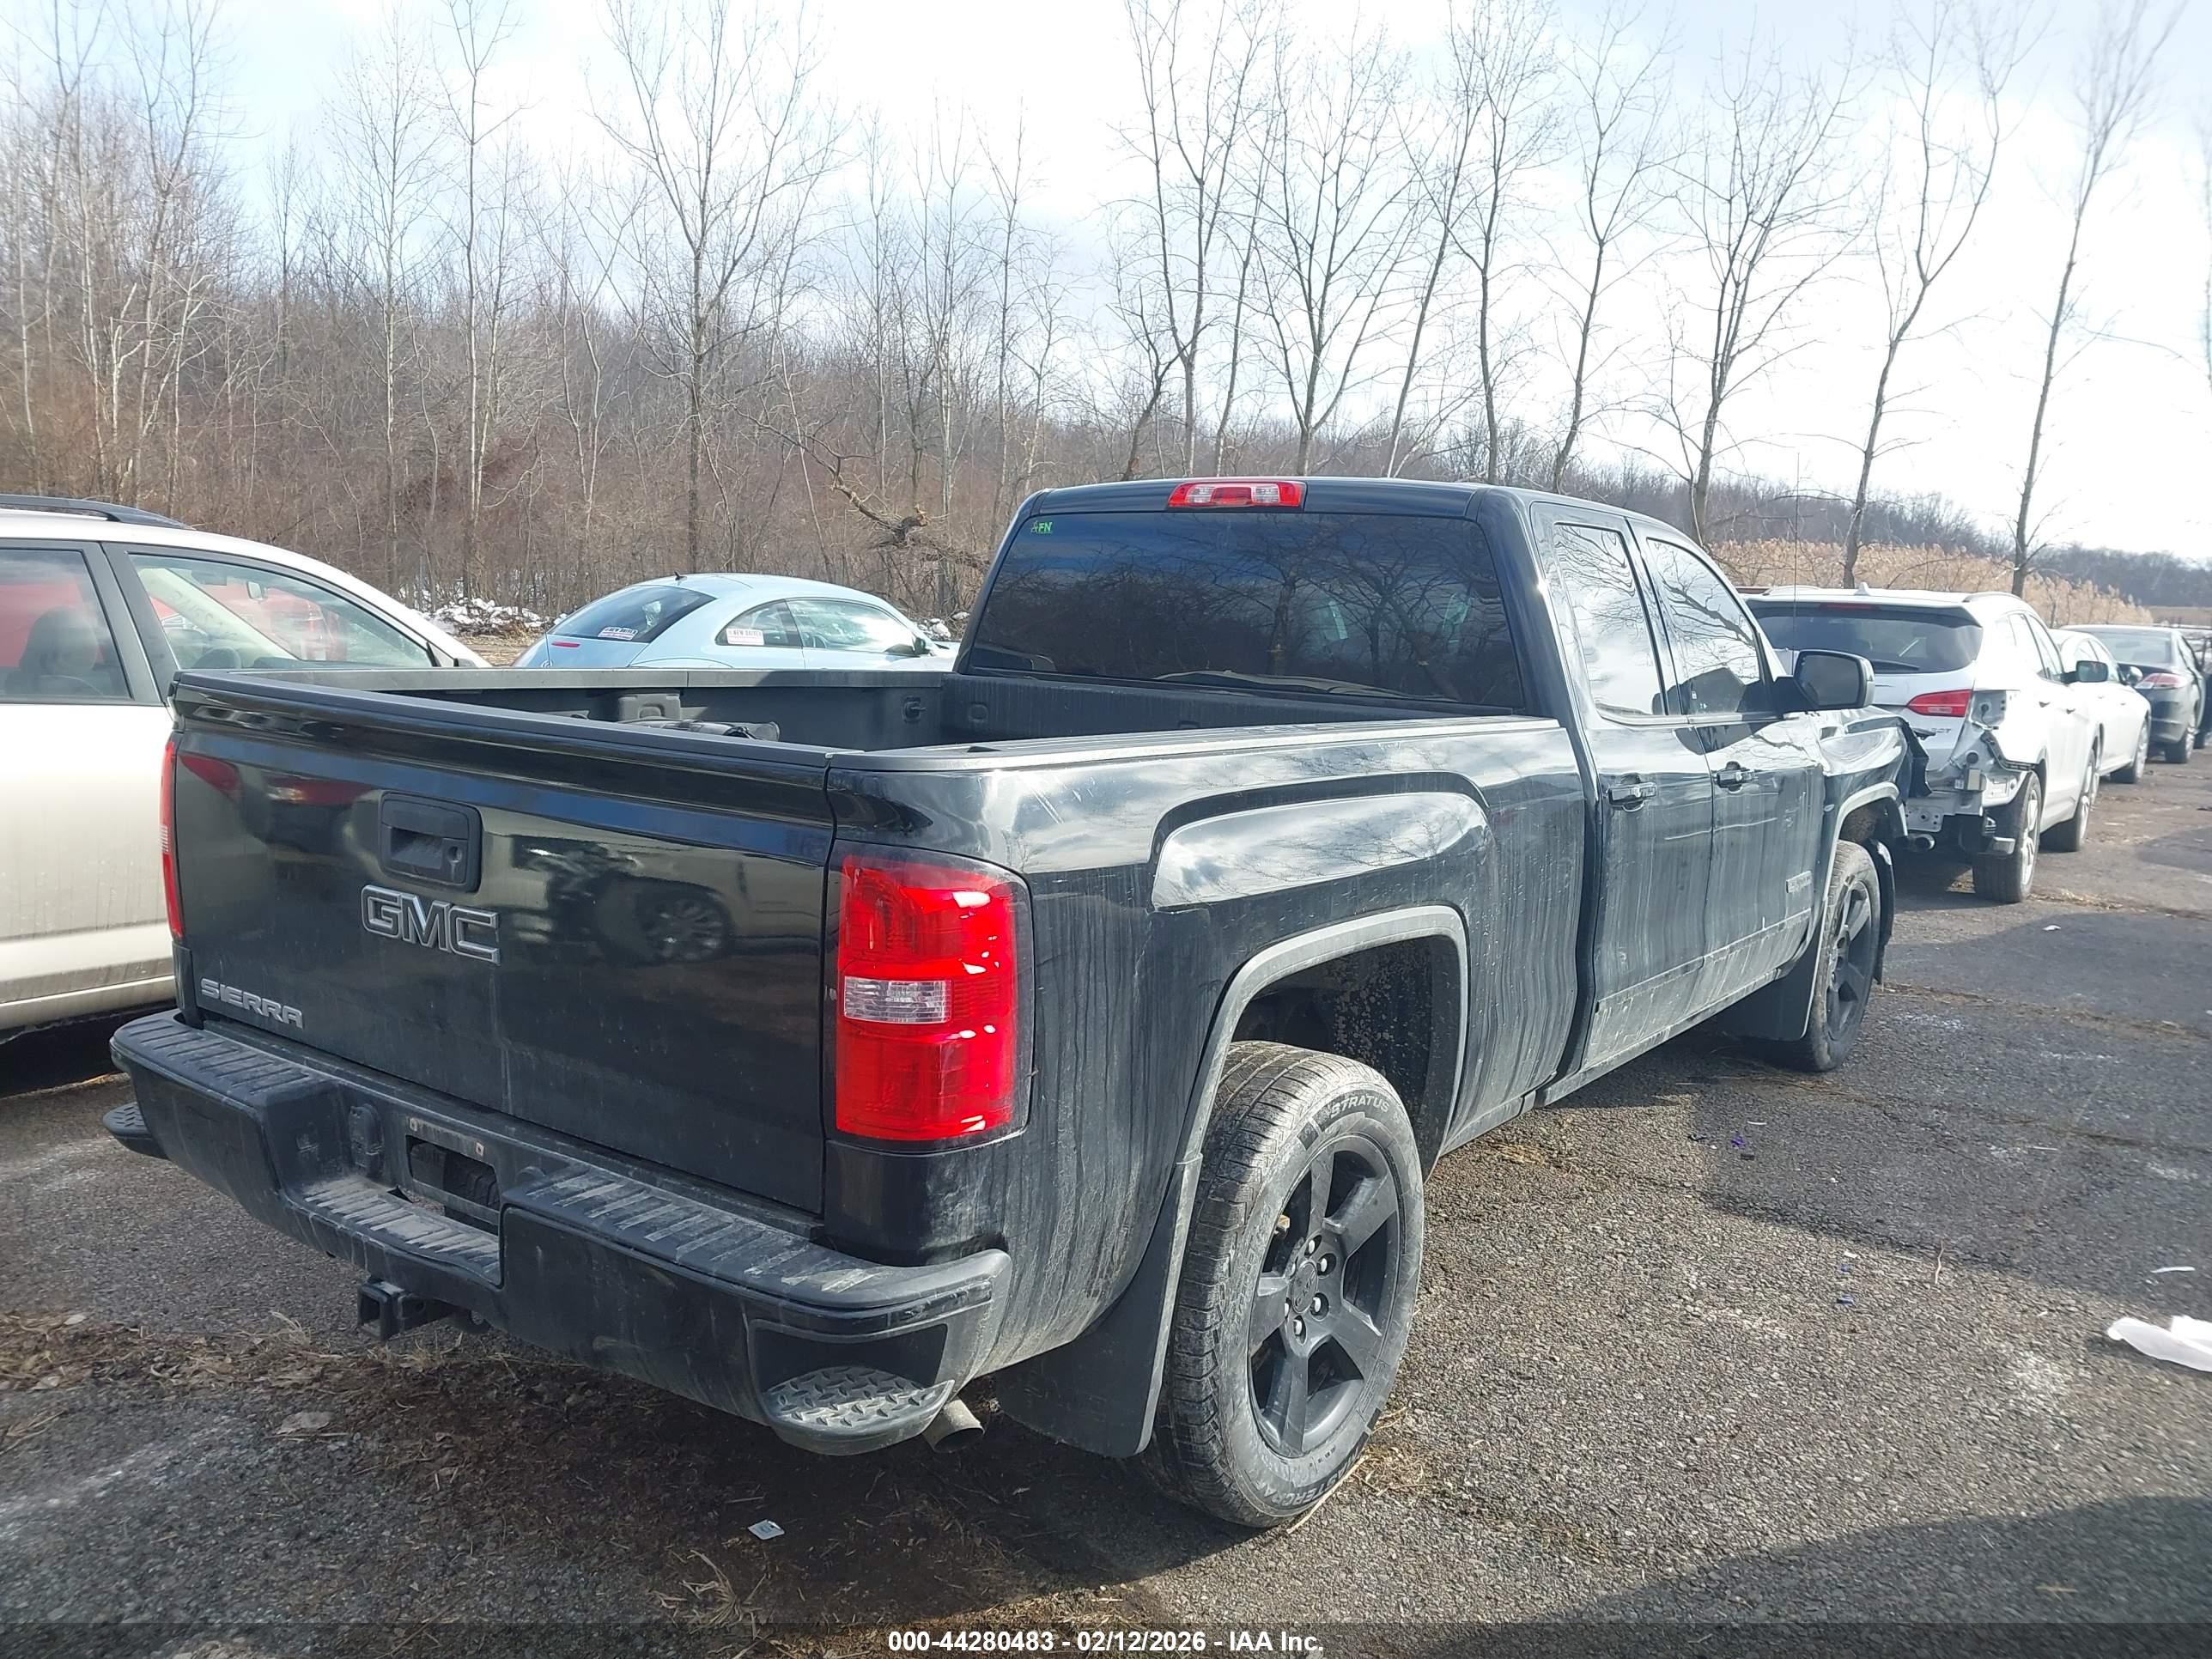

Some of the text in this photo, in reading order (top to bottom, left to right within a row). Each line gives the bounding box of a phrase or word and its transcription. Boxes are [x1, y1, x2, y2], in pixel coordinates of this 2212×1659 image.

[361, 884, 501, 966] GMC
[200, 977, 304, 1029] SIERRA
[1330, 1093, 1389, 1119] STRATUS
